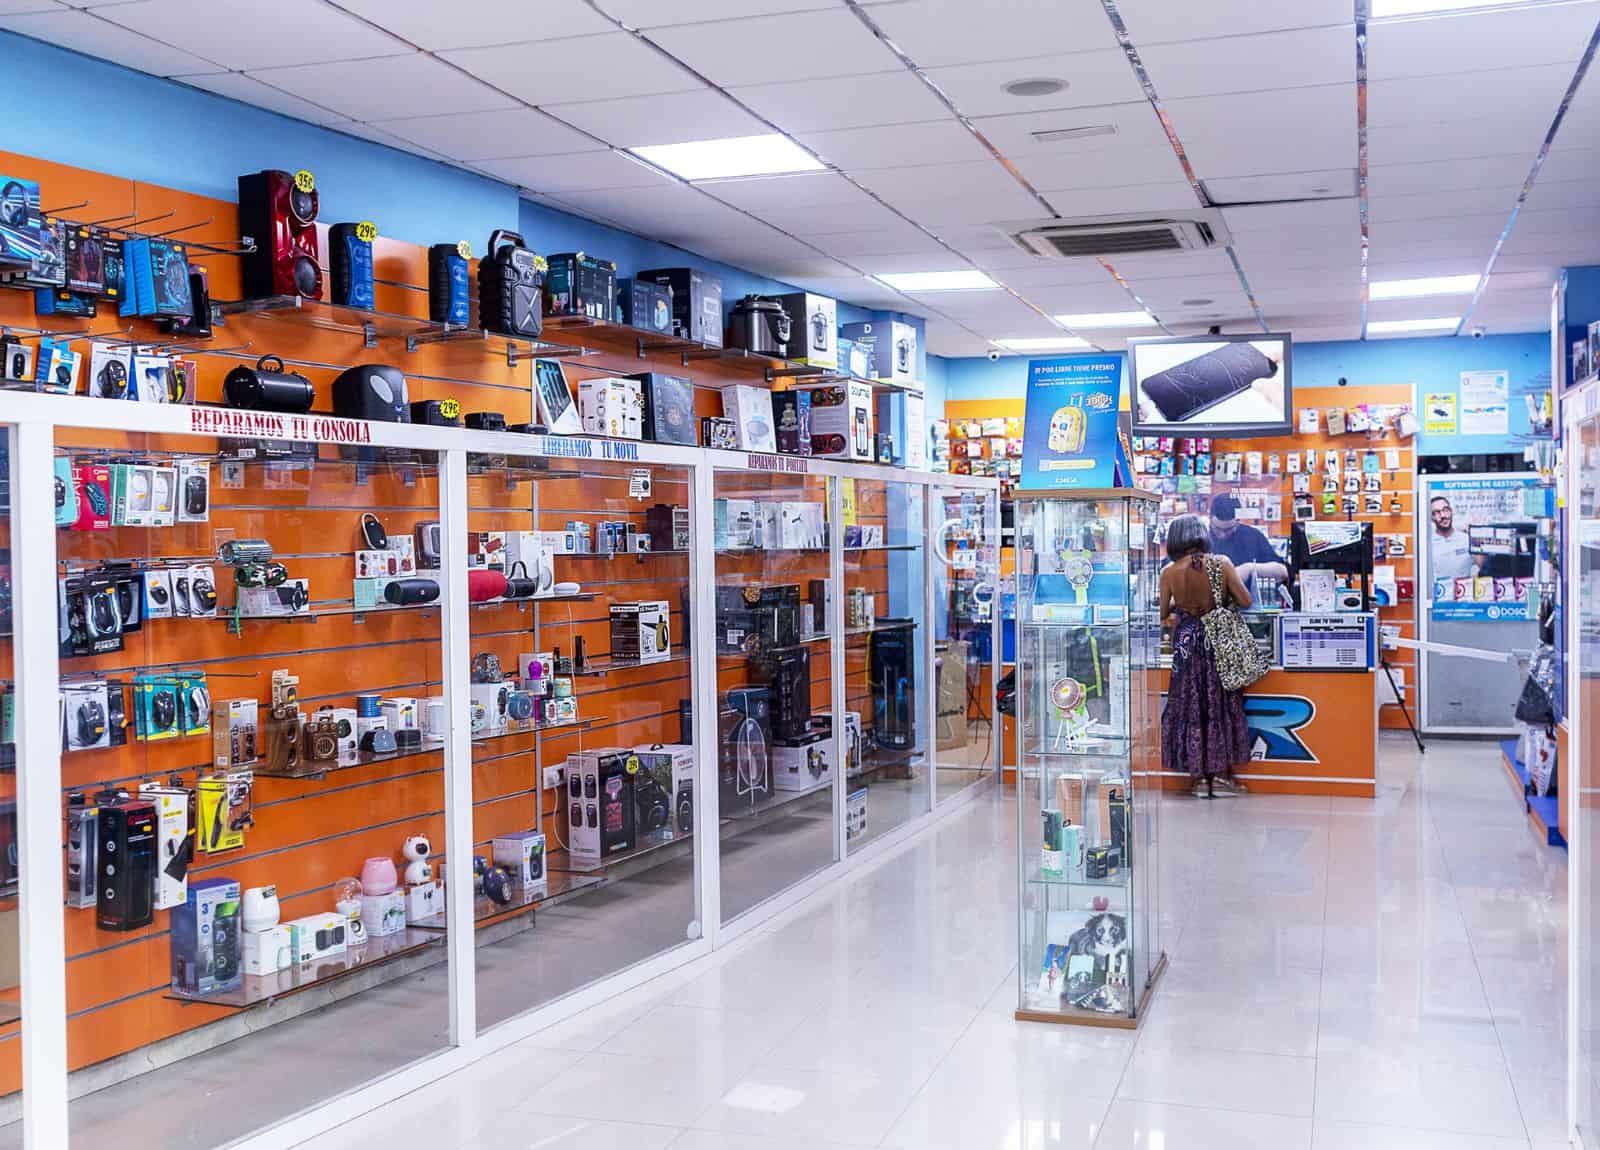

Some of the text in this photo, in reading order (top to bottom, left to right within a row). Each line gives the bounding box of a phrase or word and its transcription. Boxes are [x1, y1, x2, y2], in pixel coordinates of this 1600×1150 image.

[360, 224, 376, 239] 29€
[191, 408, 371, 443] REPARAMOS TU CONSOLA
[542, 437, 592, 458] LIBERAMOS
[601, 441, 612, 458] TU
[1443, 480, 1481, 489] SOFTWARE
[1482, 480, 1491, 488] DE
